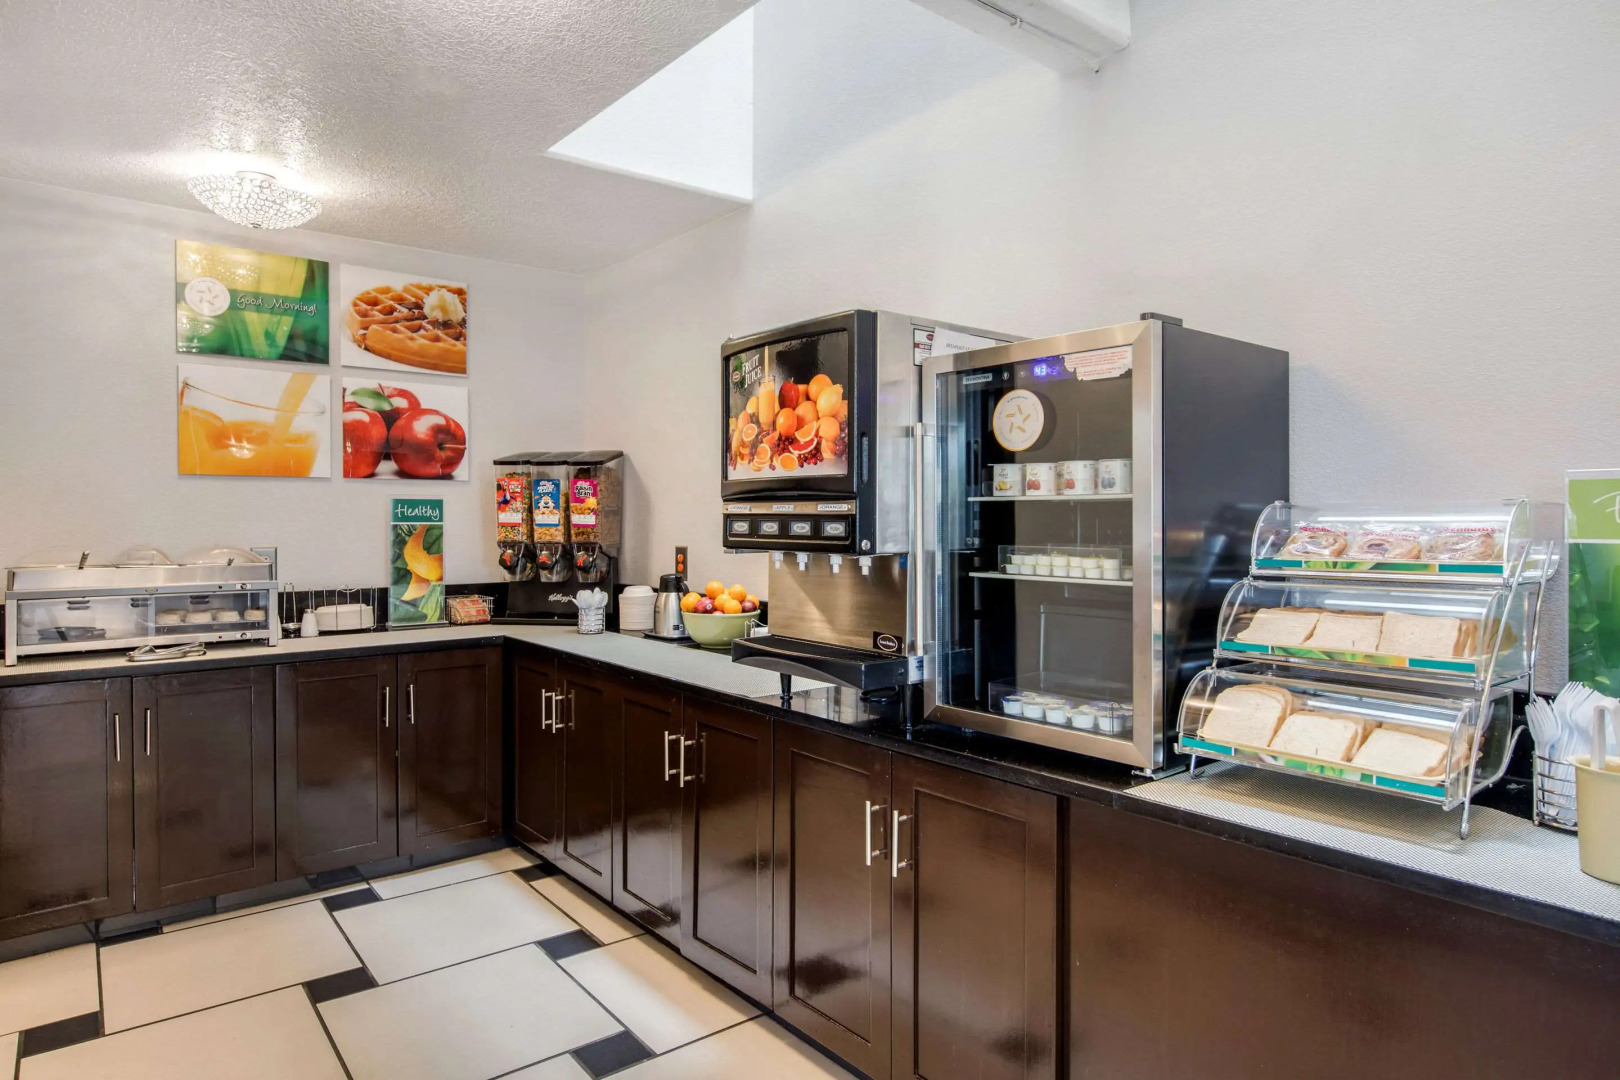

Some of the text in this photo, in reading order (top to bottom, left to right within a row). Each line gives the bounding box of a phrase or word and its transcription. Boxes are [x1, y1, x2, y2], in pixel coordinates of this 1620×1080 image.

[237, 293, 317, 316] Good Morning!
[742, 354, 760, 376] FRUIT
[744, 366, 762, 388] JUICE
[395, 504, 440, 521] Healthy
